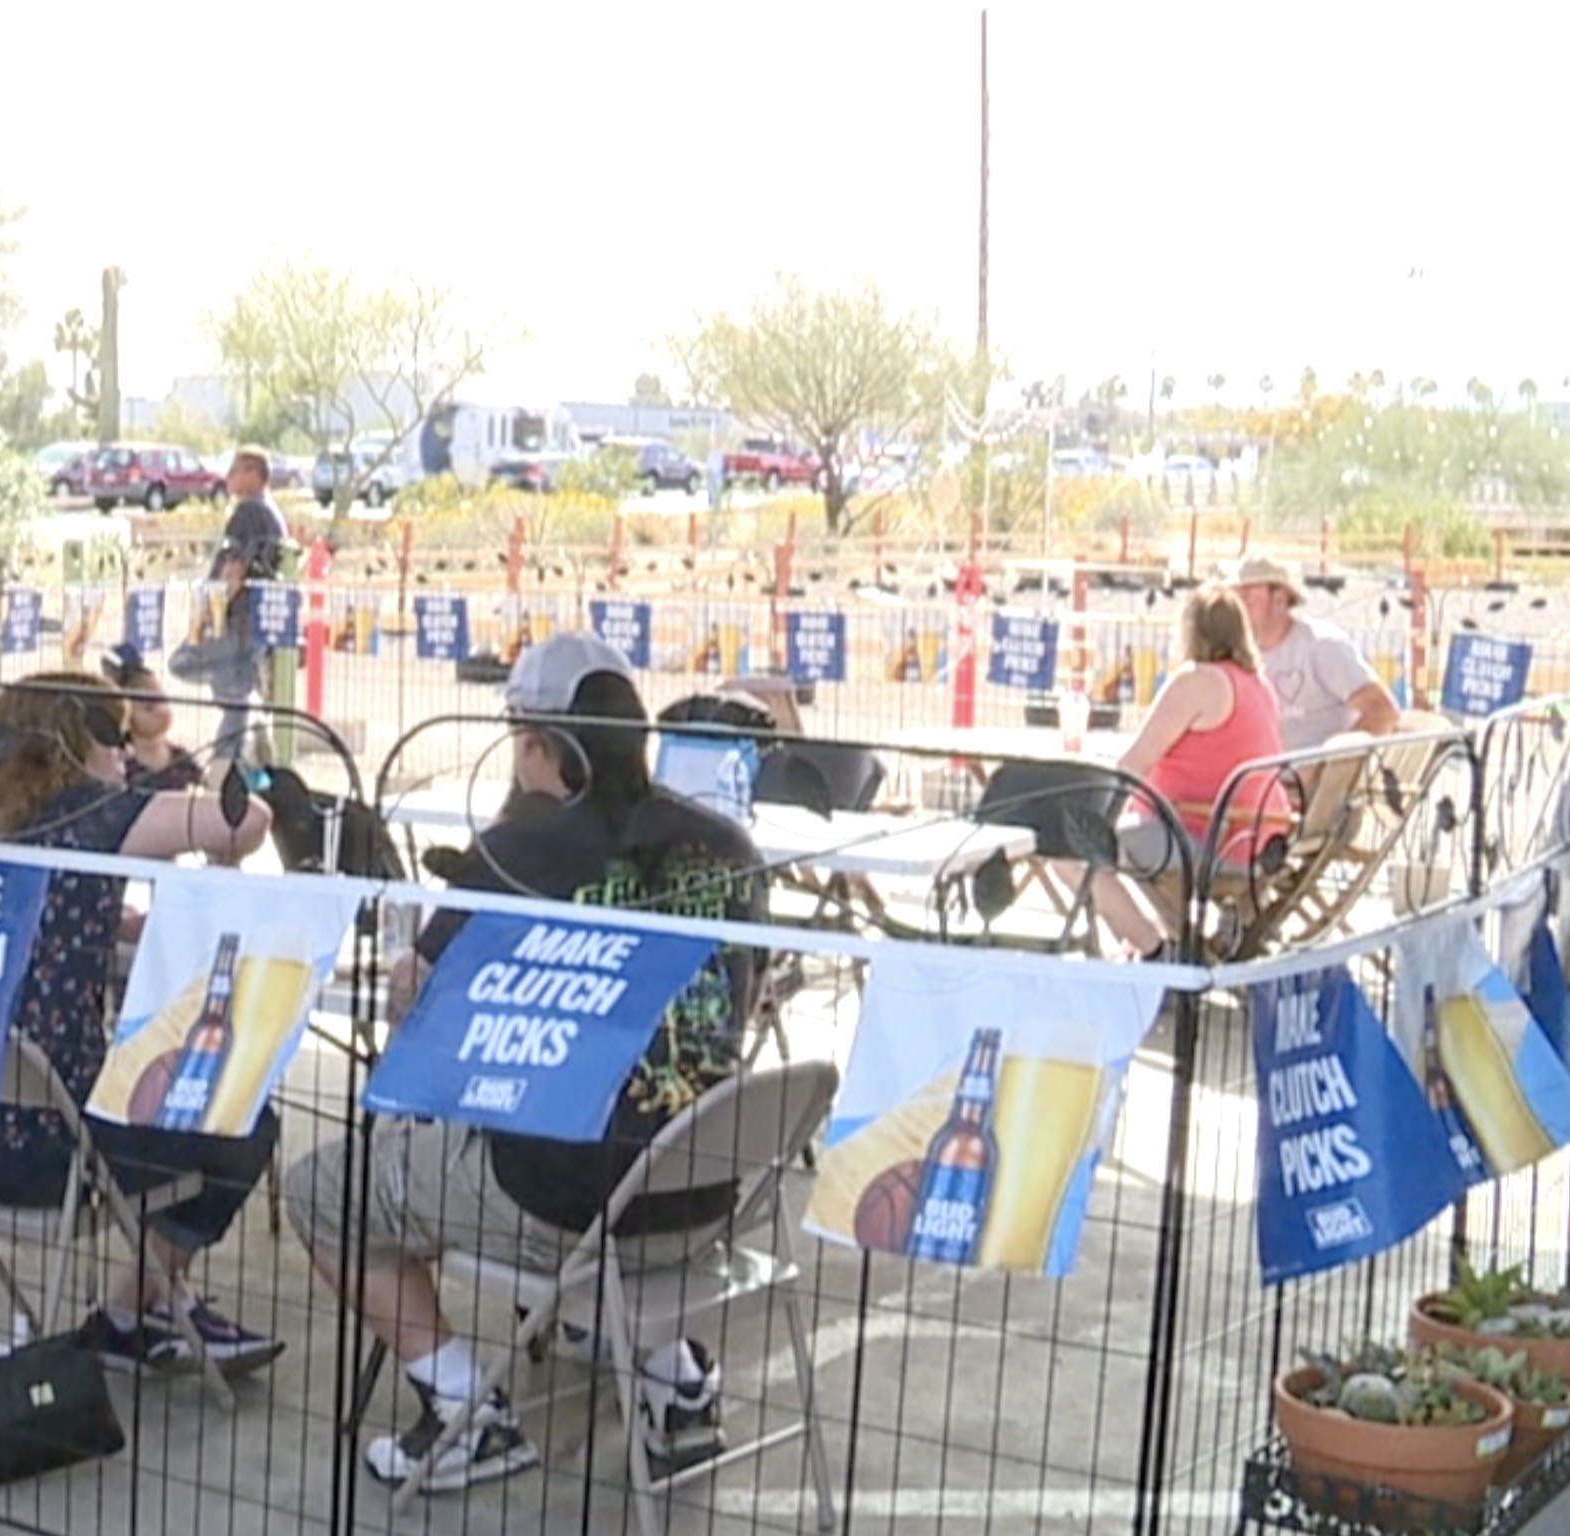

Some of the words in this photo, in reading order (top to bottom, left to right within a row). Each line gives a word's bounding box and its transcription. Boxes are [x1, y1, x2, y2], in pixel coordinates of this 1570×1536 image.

[512, 923, 641, 972] MAKE
[467, 961, 628, 1016] CLUTCH
[457, 1012, 580, 1067] PICKS
[1275, 989, 1322, 1054] MAKE
[1268, 1053, 1359, 1128] CLUTCH
[1279, 1123, 1373, 1198] PICKS
[913, 1213, 978, 1242] LIGHT
[924, 1197, 976, 1220] BUD
